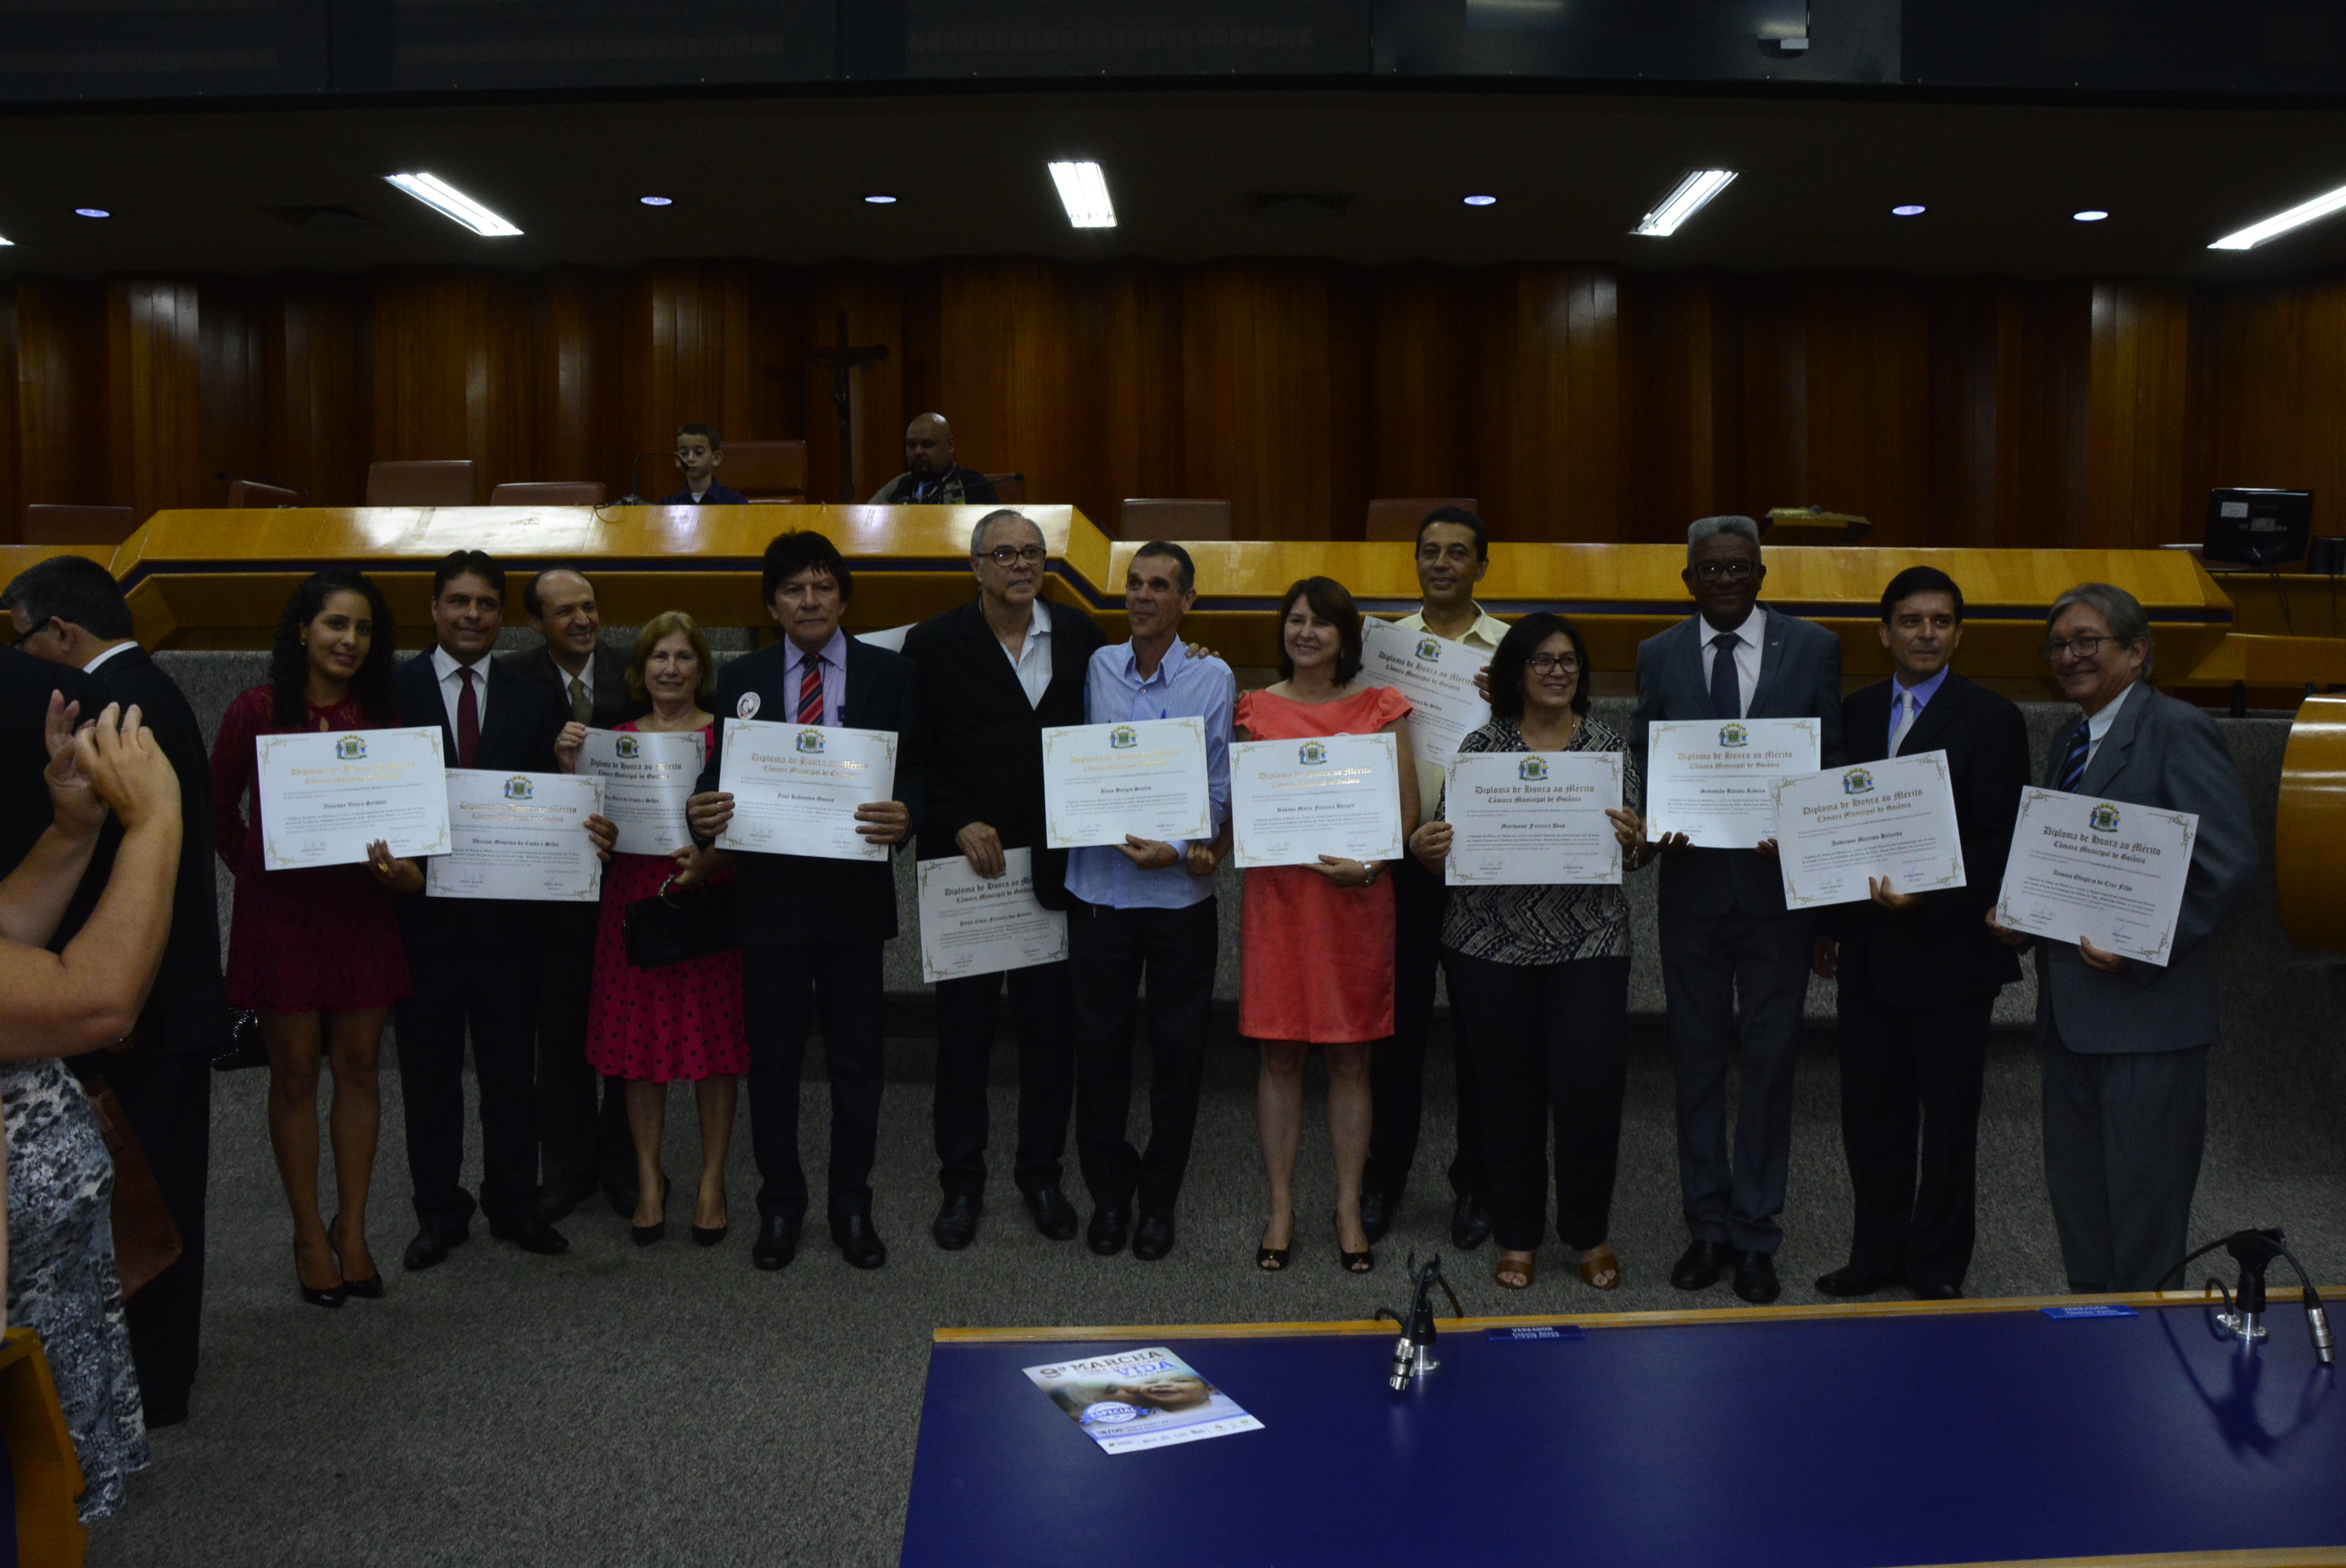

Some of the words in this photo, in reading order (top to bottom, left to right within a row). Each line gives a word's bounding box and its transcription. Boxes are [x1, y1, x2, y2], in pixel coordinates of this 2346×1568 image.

[1677, 752, 1711, 761] Diploma
[1724, 751, 1750, 760] Honra
[1764, 750, 1792, 760] Mérito
[1475, 786, 1509, 795] Diploma
[1524, 785, 1551, 794] Honra
[1565, 783, 1594, 793] Mérito
[1803, 802, 1838, 816] Diploma
[1840, 800, 1849, 808] de
[1852, 797, 1879, 808] Honra
[1894, 789, 1923, 801] Mérito
[1817, 813, 1842, 823] Câmara
[1843, 808, 1876, 819] Municipal
[1886, 802, 1911, 812] Goiânia
[2043, 826, 2078, 840] Diploma
[2080, 833, 2088, 843] de
[2091, 834, 2118, 848] Honra
[2119, 841, 2130, 850] ao
[2130, 842, 2161, 856] Mérito
[2054, 840, 2078, 851] Câmara
[2078, 845, 2111, 859] Municipal
[2112, 851, 2119, 859] de
[2120, 852, 2145, 864] Goiânia
[945, 885, 975, 897] Diploma
[1071, 1351, 1163, 1372] MARCHA
[1114, 1360, 1175, 1376] VIDA
